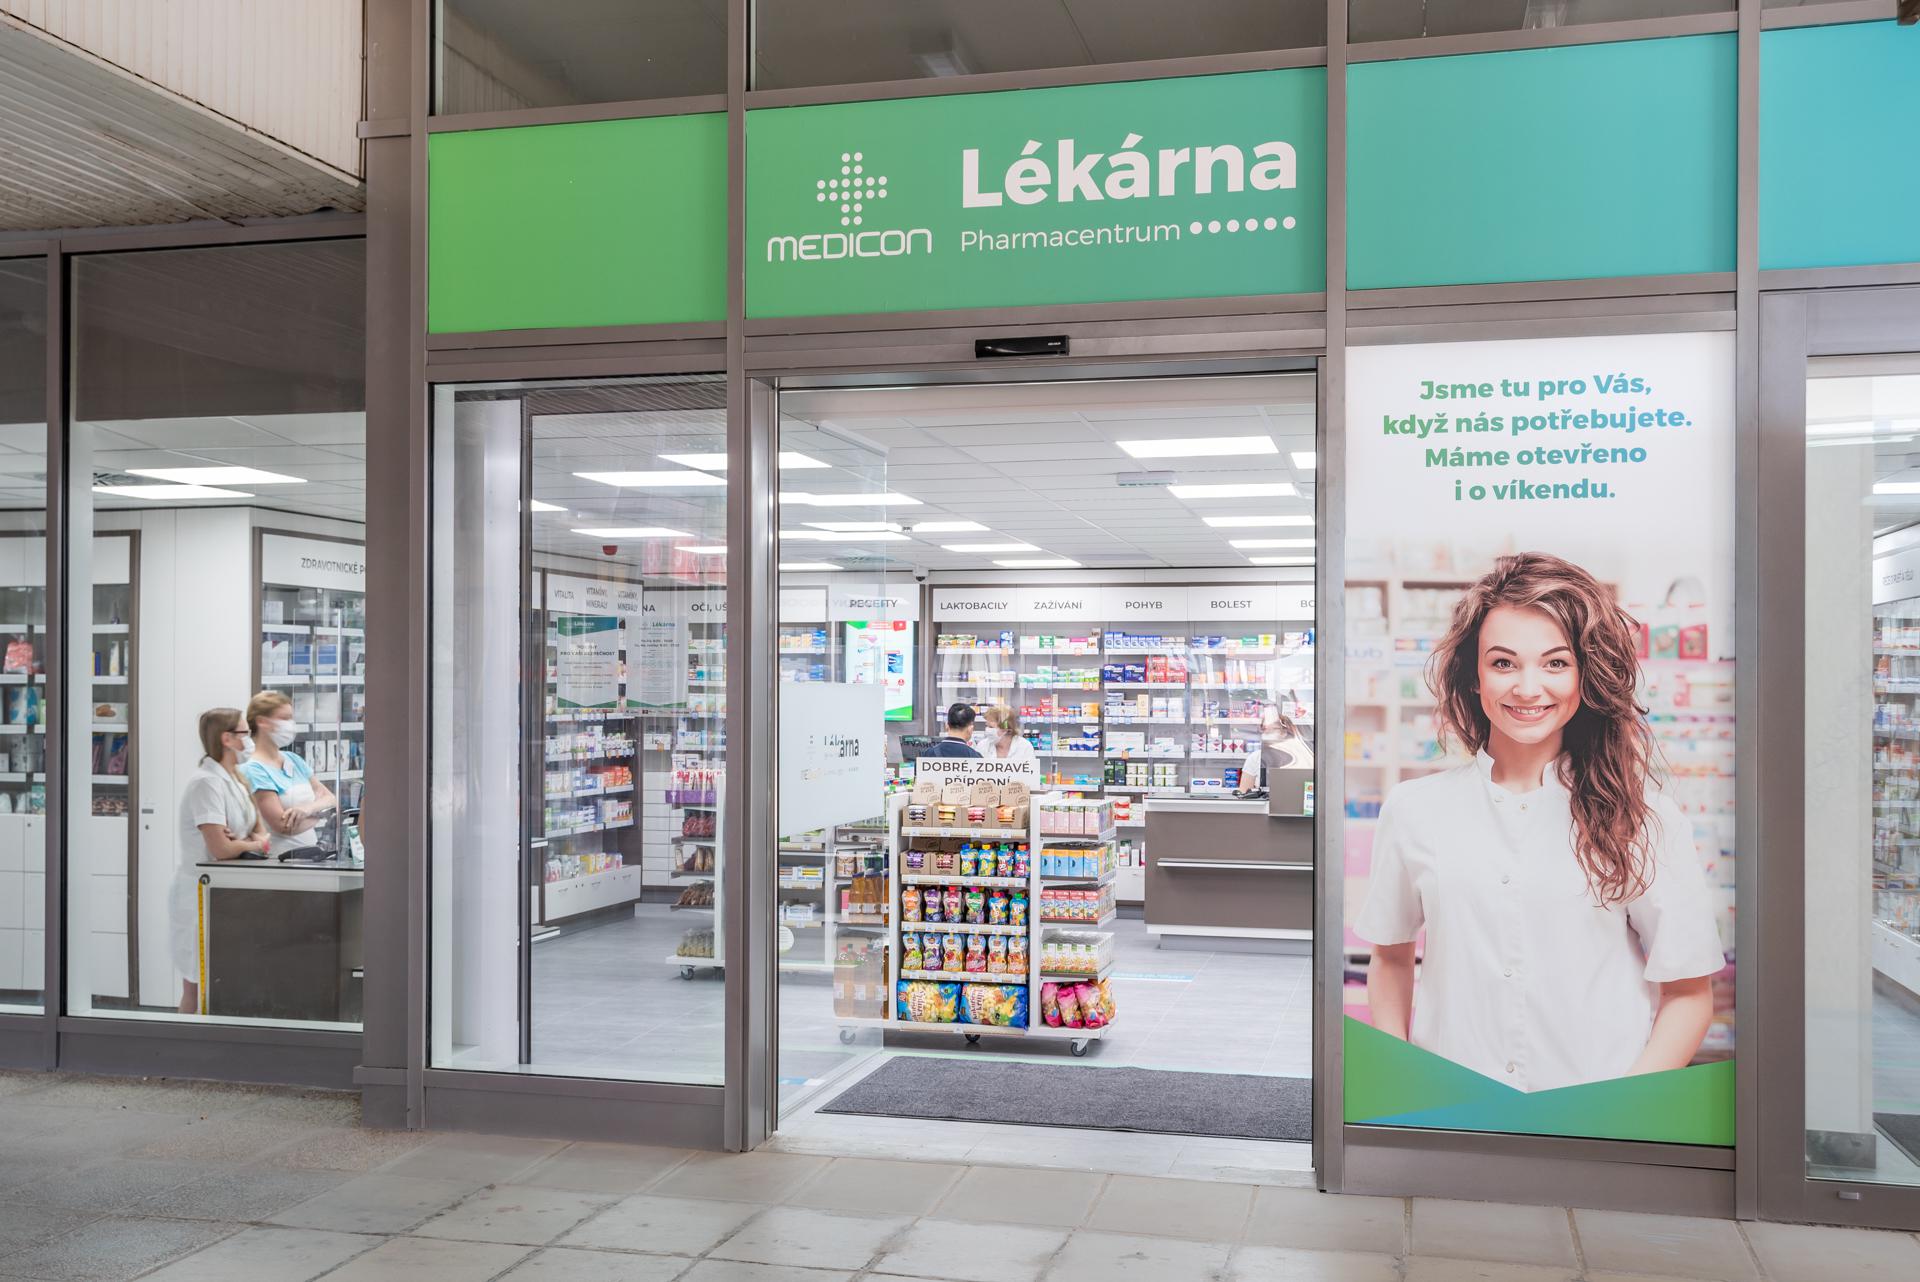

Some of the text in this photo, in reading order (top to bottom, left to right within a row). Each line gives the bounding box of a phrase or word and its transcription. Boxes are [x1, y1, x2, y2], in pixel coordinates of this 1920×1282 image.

[962, 132, 1297, 208] Lékárna
[767, 228, 932, 262] MEDICON
[960, 222, 1181, 252] Pharmacentrum
[1419, 373, 1652, 401] Jsme tu pro Vás,
[1383, 406, 1693, 439] když nás potřebujete.
[1425, 443, 1647, 467] Máme otevřeno
[1455, 478, 1616, 501] i o víkendu.
[300, 557, 358, 575] ZDRAVOTNICKÉ
[691, 602, 713, 613] OČI,
[940, 601, 1008, 611] LAKTOBACILY
[1033, 600, 1082, 610] ZAŽÍVÁNÍ
[1125, 600, 1163, 610] POHYB
[1210, 600, 1252, 609] BOLEST
[922, 759, 1034, 775] DOBRÉ, ZDRAVÉ,
